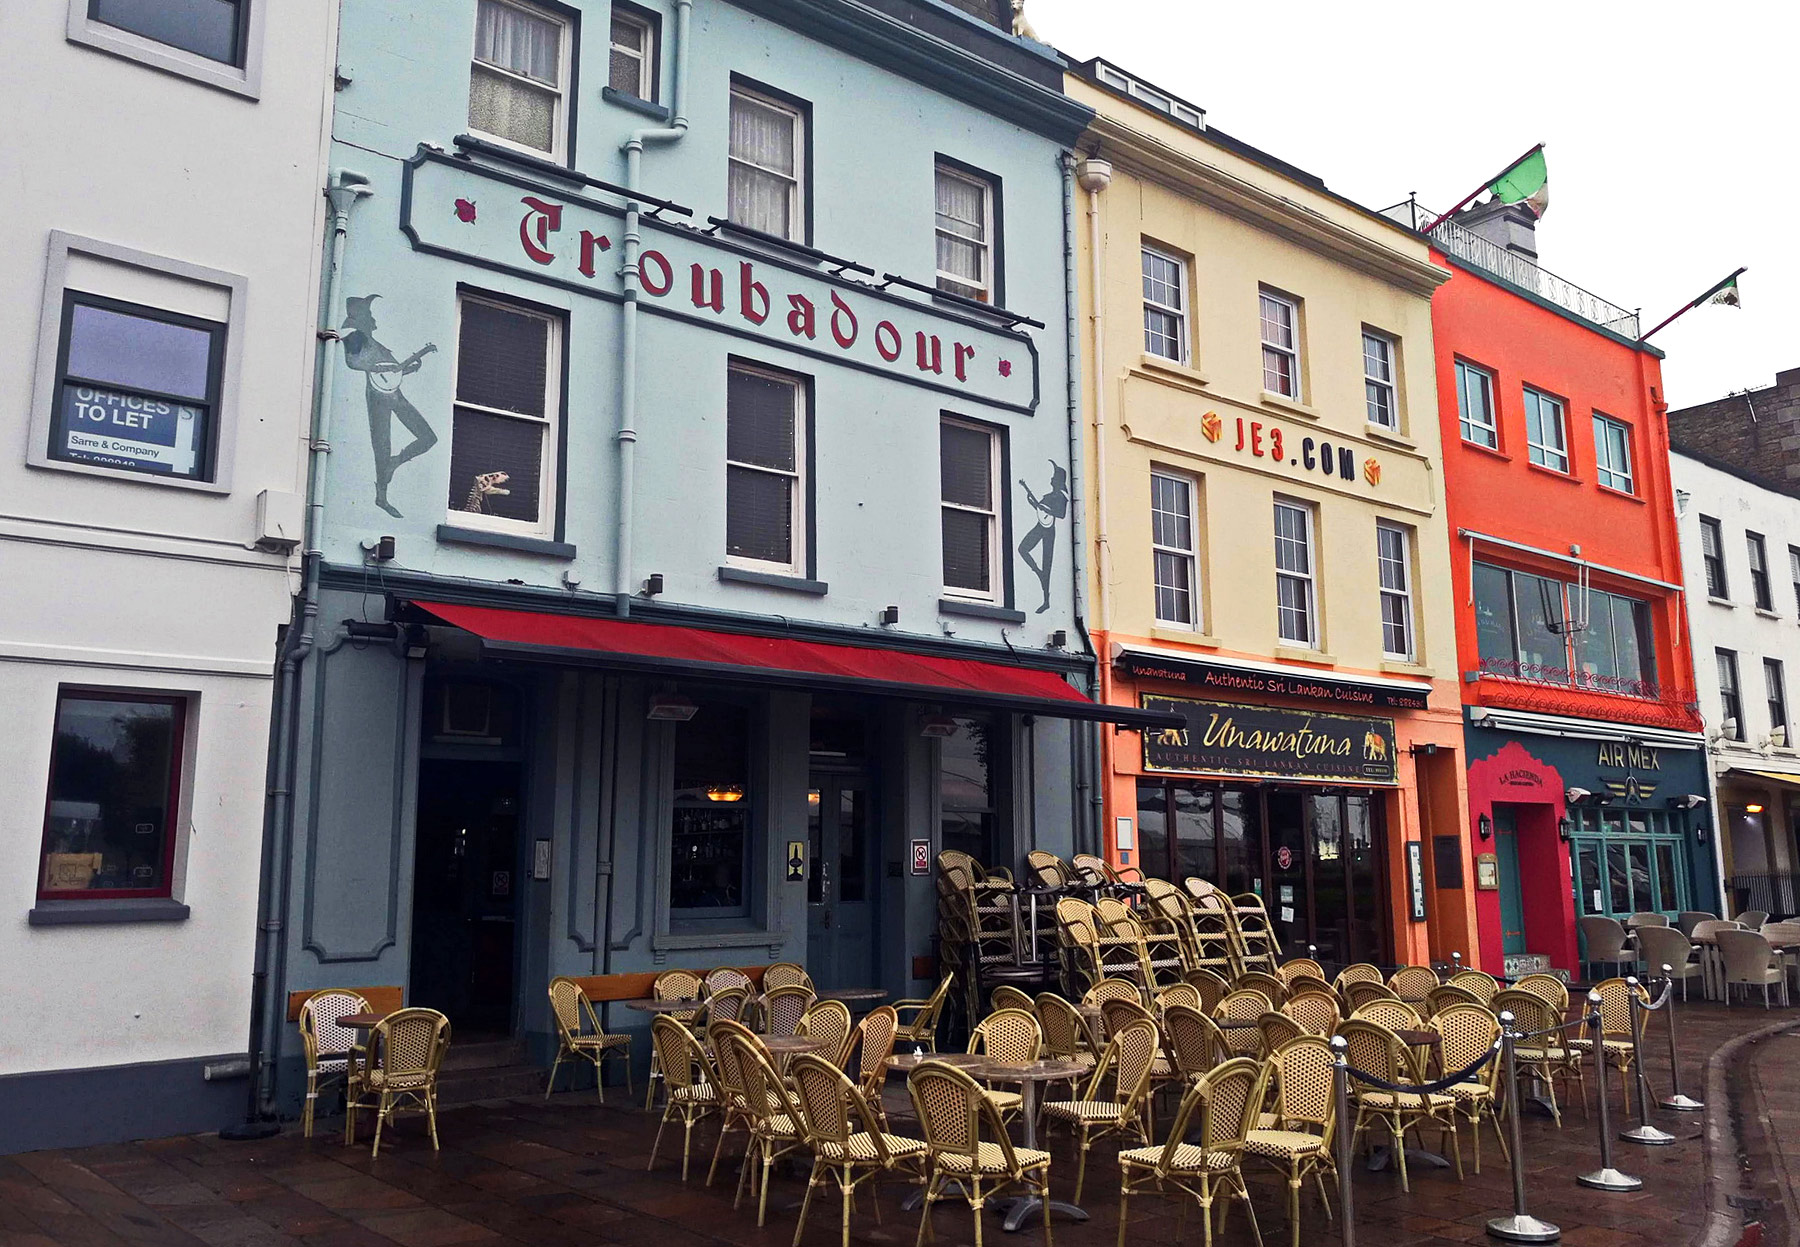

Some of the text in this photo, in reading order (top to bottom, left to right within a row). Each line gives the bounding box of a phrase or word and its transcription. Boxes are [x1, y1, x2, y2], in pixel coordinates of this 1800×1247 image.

[519, 197, 976, 383] Troubadour
[76, 388, 170, 415] OFFICES
[75, 402, 153, 429] TO LET
[71, 435, 160, 458] Sarre & Company
[1235, 417, 1355, 482] JE3.COM
[1205, 671, 1265, 691] Authentic
[1266, 676, 1285, 693] Sri
[1288, 681, 1333, 698] Lankan
[1335, 685, 1374, 703] Cuisine
[1202, 713, 1352, 759] Unawatuna
[1156, 752, 1360, 773] AUTHENTIC SRI LANKAN CUISINE
[1598, 743, 1660, 770] AIR MEX
